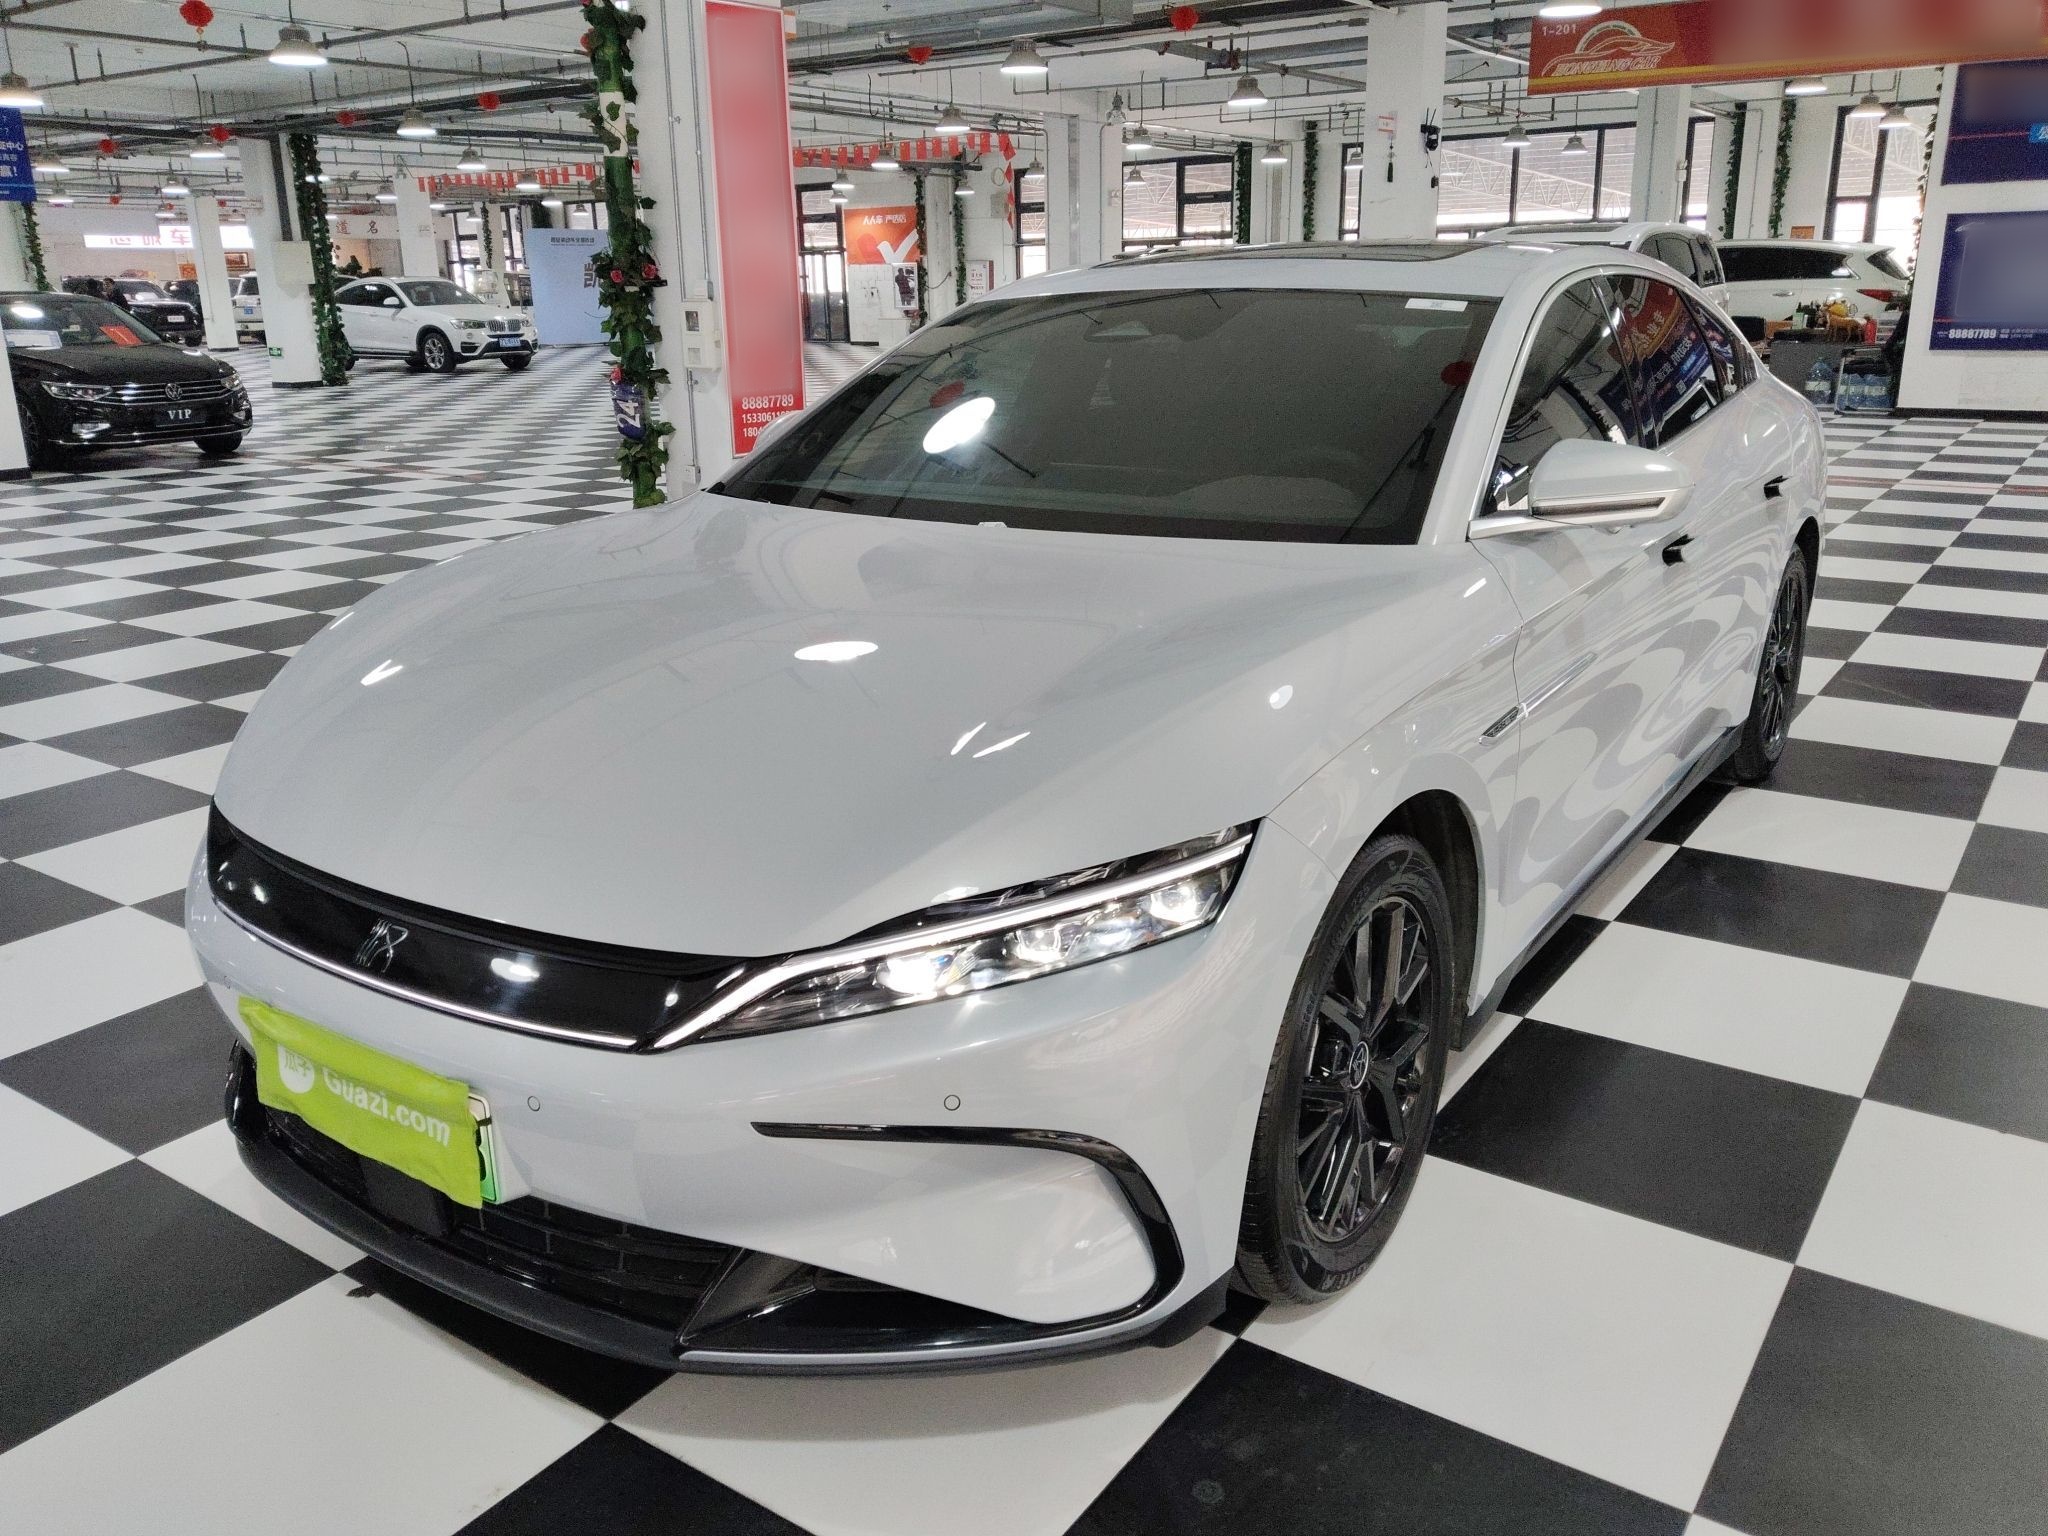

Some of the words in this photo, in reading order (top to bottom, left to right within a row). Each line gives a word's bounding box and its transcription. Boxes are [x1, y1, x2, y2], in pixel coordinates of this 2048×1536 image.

[1542, 24, 1577, 36] 1-201
[741, 393, 794, 410] 88887789
[167, 408, 192, 420] VIP
[616, 400, 641, 429] 24
[742, 426, 762, 438] 180
[323, 1067, 450, 1147] Guazi.com
